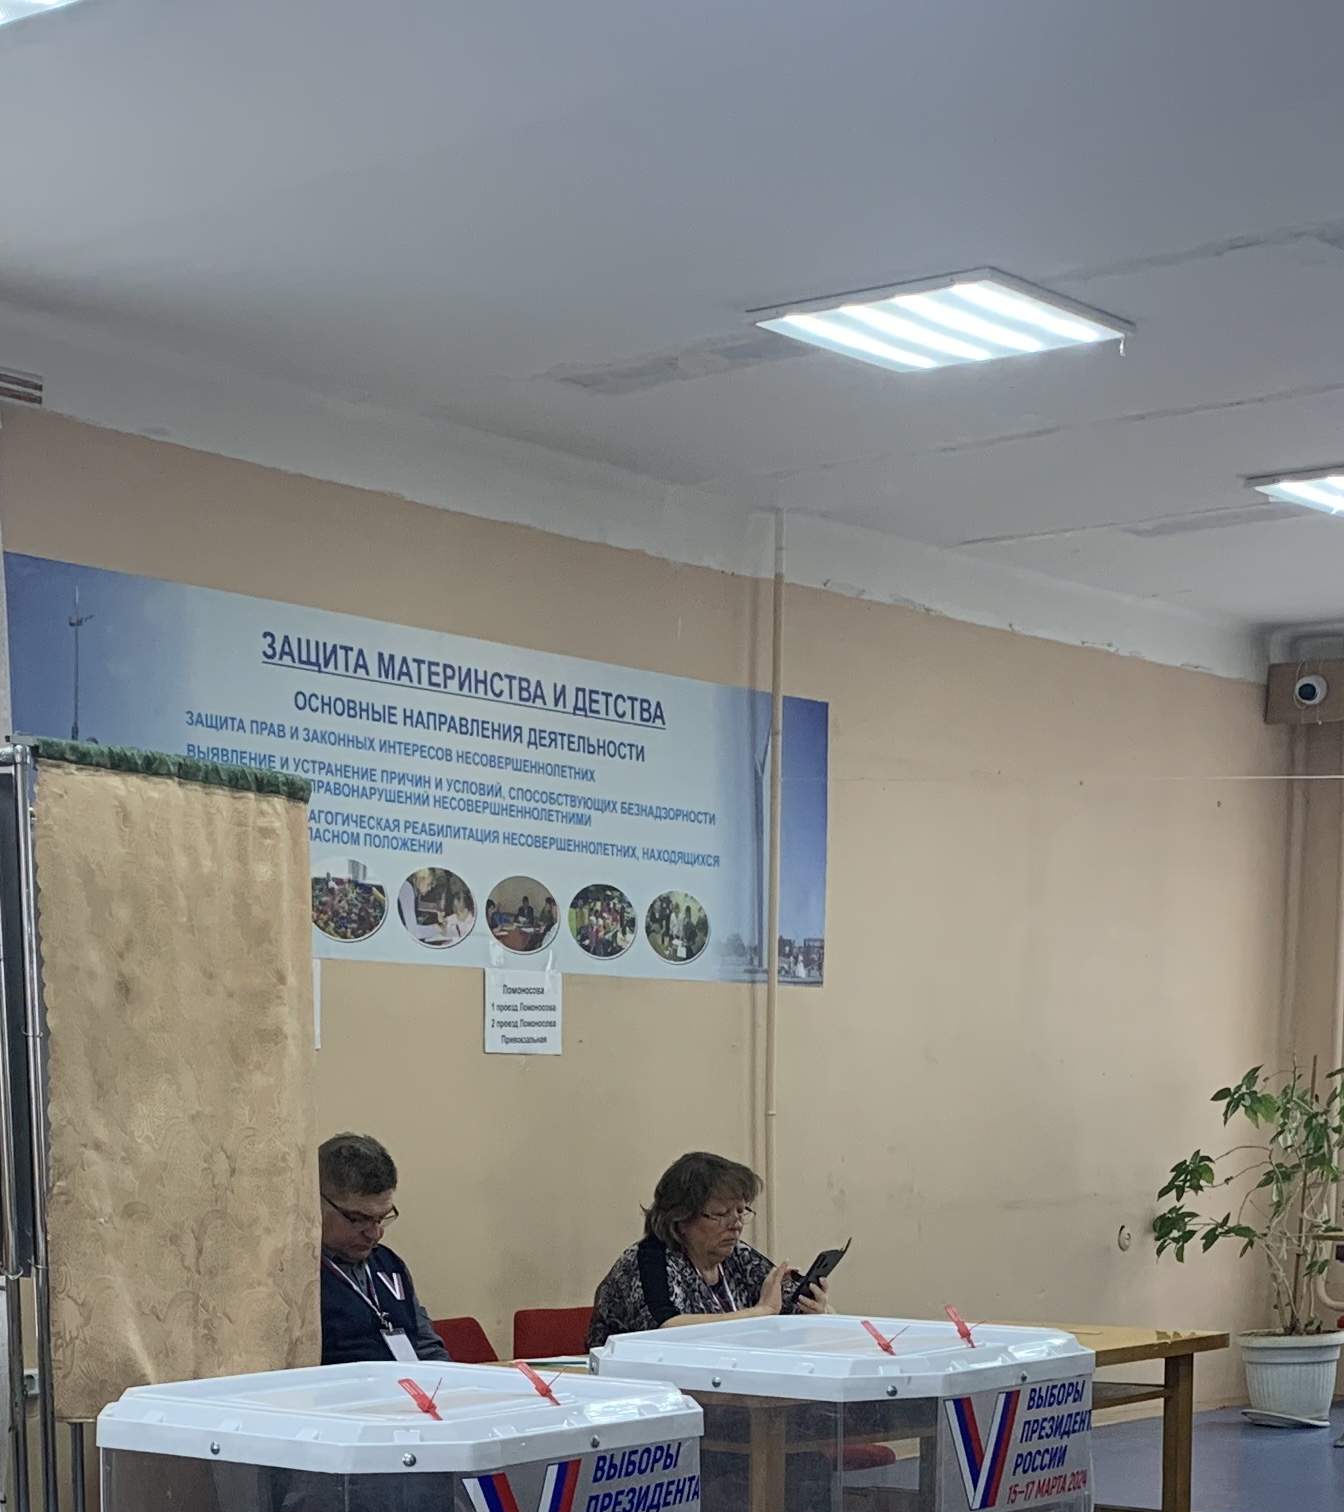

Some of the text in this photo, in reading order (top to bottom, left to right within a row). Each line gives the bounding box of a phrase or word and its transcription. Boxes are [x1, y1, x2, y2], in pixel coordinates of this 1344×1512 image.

[262, 631, 666, 726] ЗАЩИТА МАТЕРИНСТВА И ДЕТСТВА
[186, 711, 596, 783] ЗАЩИТА ПРАВ И ЗАКОННЫХ ИНТЕРЕСОВ НЕСОВЕРШЕННОЛЕТНИХ
[294, 691, 645, 763] ОСНОВНЫЕ НАПРАВЛЕНИЯ ДЕЯТЕЛЬНОСТИ
[187, 743, 276, 769] ВЫЯВЛЕНИЕ
[280, 756, 289, 771] И
[293, 757, 377, 783] УСТРАНЕНИЕ
[381, 769, 431, 790] ПРИЧИН
[435, 776, 442, 791] И
[509, 786, 618, 814] СПОСОБСТВУЮЩИХ
[621, 801, 716, 826] БЕЗНАДЗОРНОСТИ
[364, 828, 443, 854] ПОЛОЖЕНИИ
[404, 819, 499, 845] РЕАБИЛИТАЦИЯ
[642, 847, 720, 869] НАХОДЯЩИХСЯ
[1026, 1379, 1086, 1411] ВЫБОРЫ
[1019, 1409, 1092, 1444] ПРЕЗИДЕНТ
[592, 1442, 682, 1483] ВЫБОРЫ
[1012, 1444, 1068, 1477] РОССИИ
[1035, 1474, 1067, 1500] МАРТА
[1067, 1469, 1088, 1493] 2024
